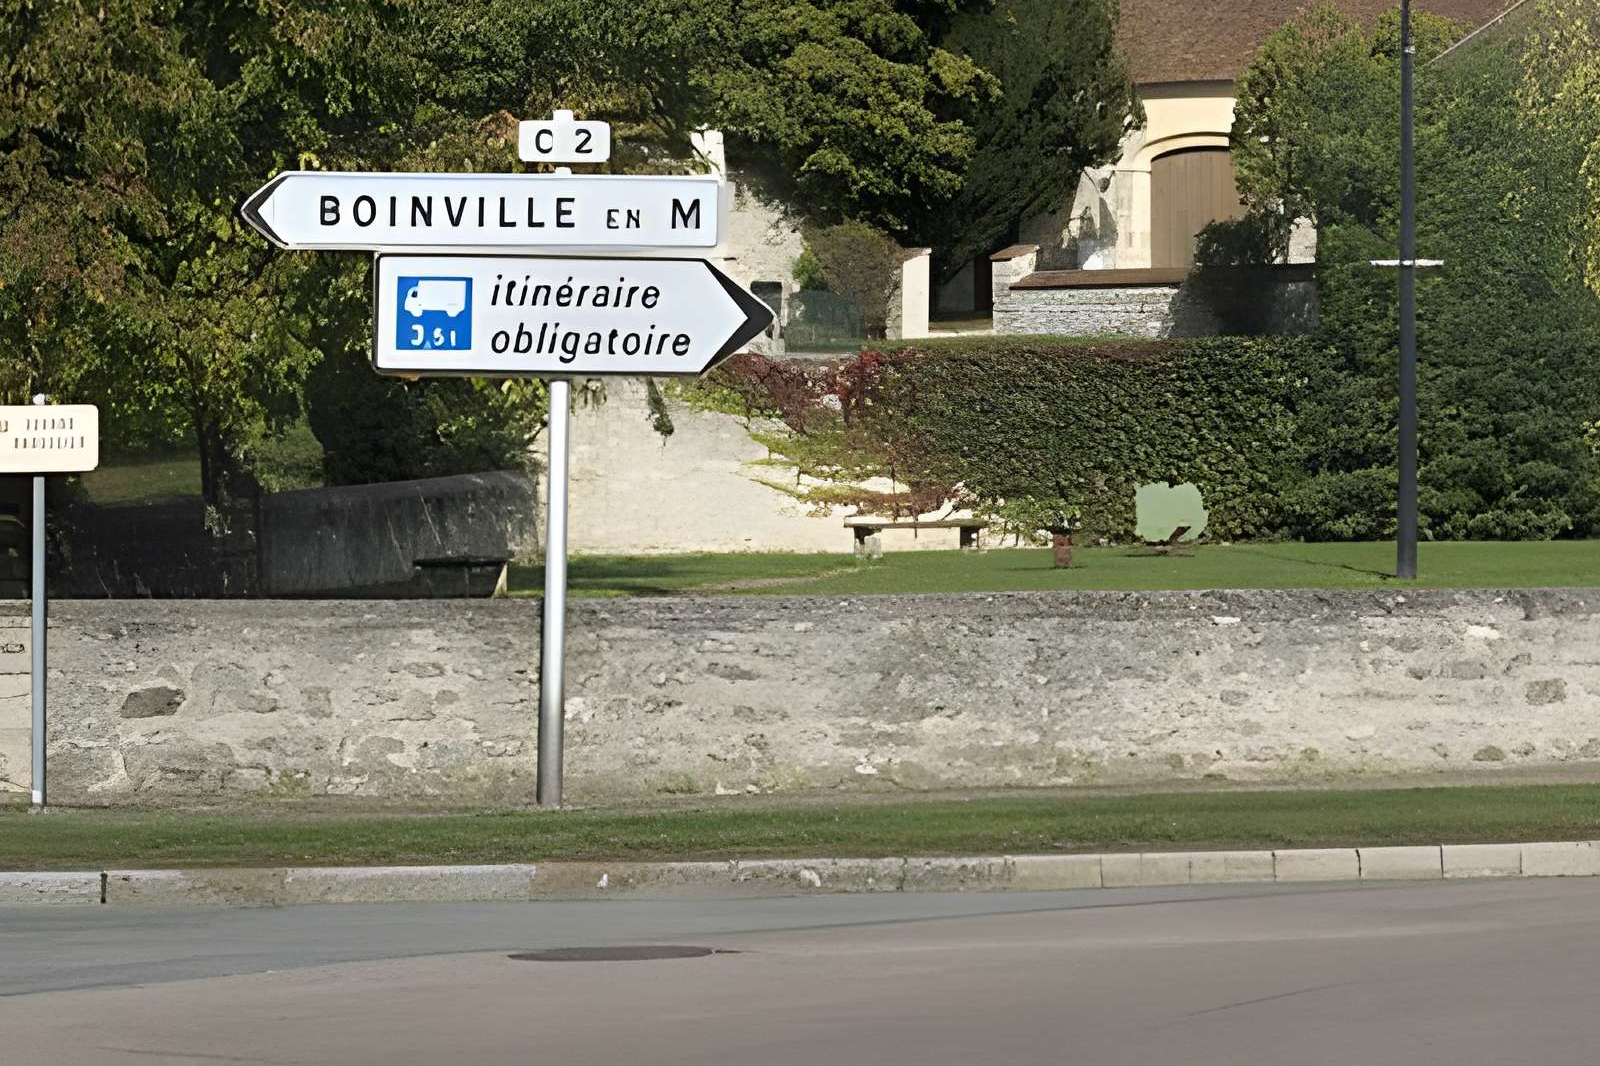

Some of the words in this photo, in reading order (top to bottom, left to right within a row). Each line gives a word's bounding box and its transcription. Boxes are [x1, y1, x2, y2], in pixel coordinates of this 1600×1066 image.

[574, 128, 593, 154] 2
[319, 194, 577, 228] BOINVILLE
[606, 207, 642, 230] EN
[671, 197, 702, 230] M
[490, 273, 661, 310] itinéraire
[490, 322, 692, 364] obligatoire
